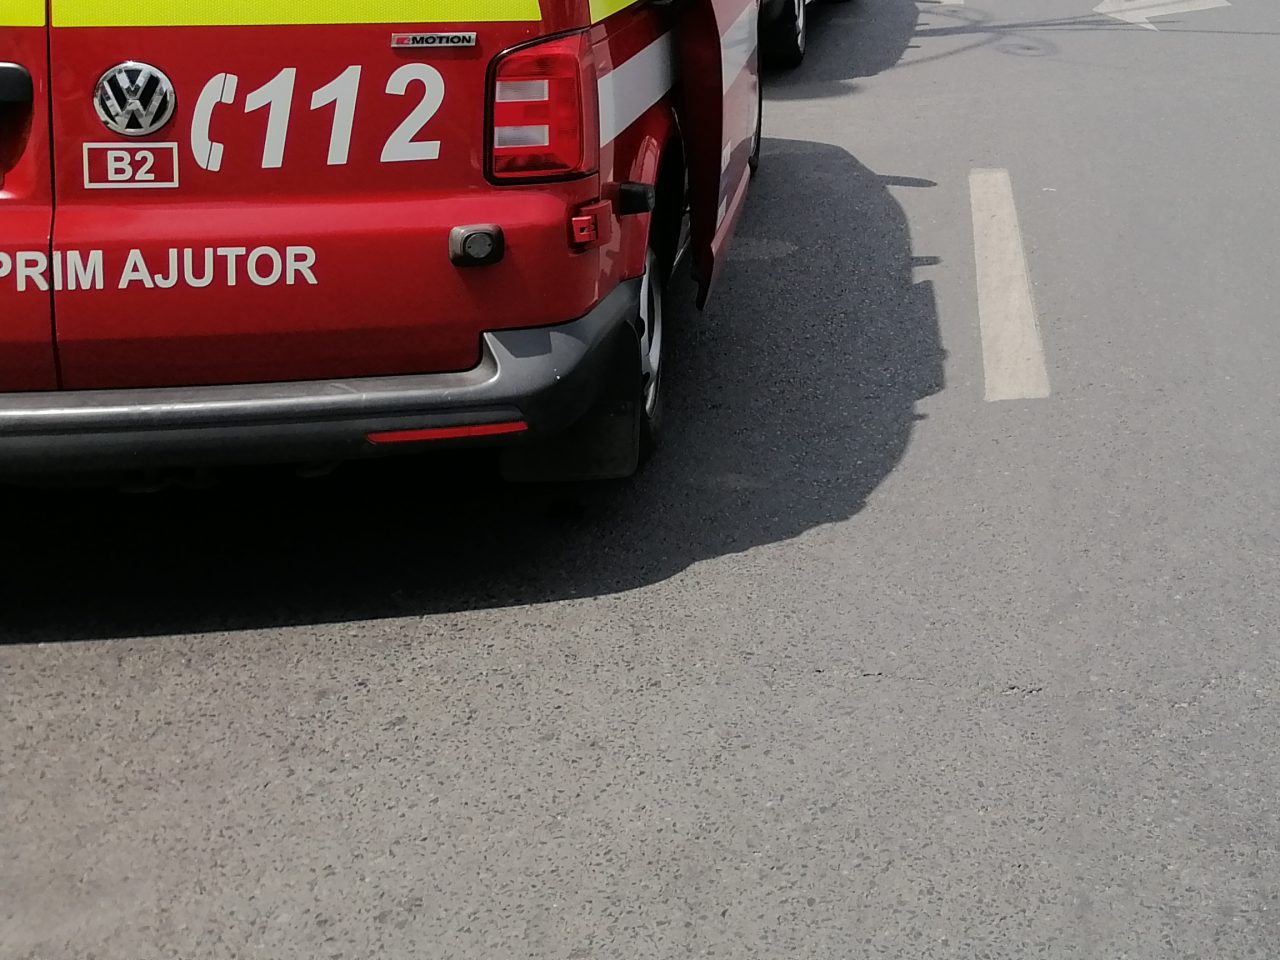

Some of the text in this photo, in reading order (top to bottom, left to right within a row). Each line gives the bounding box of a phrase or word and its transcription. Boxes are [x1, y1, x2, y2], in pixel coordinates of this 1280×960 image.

[244, 63, 445, 169] 112
[107, 150, 155, 181] B2
[118, 245, 318, 289] AJUTOR
